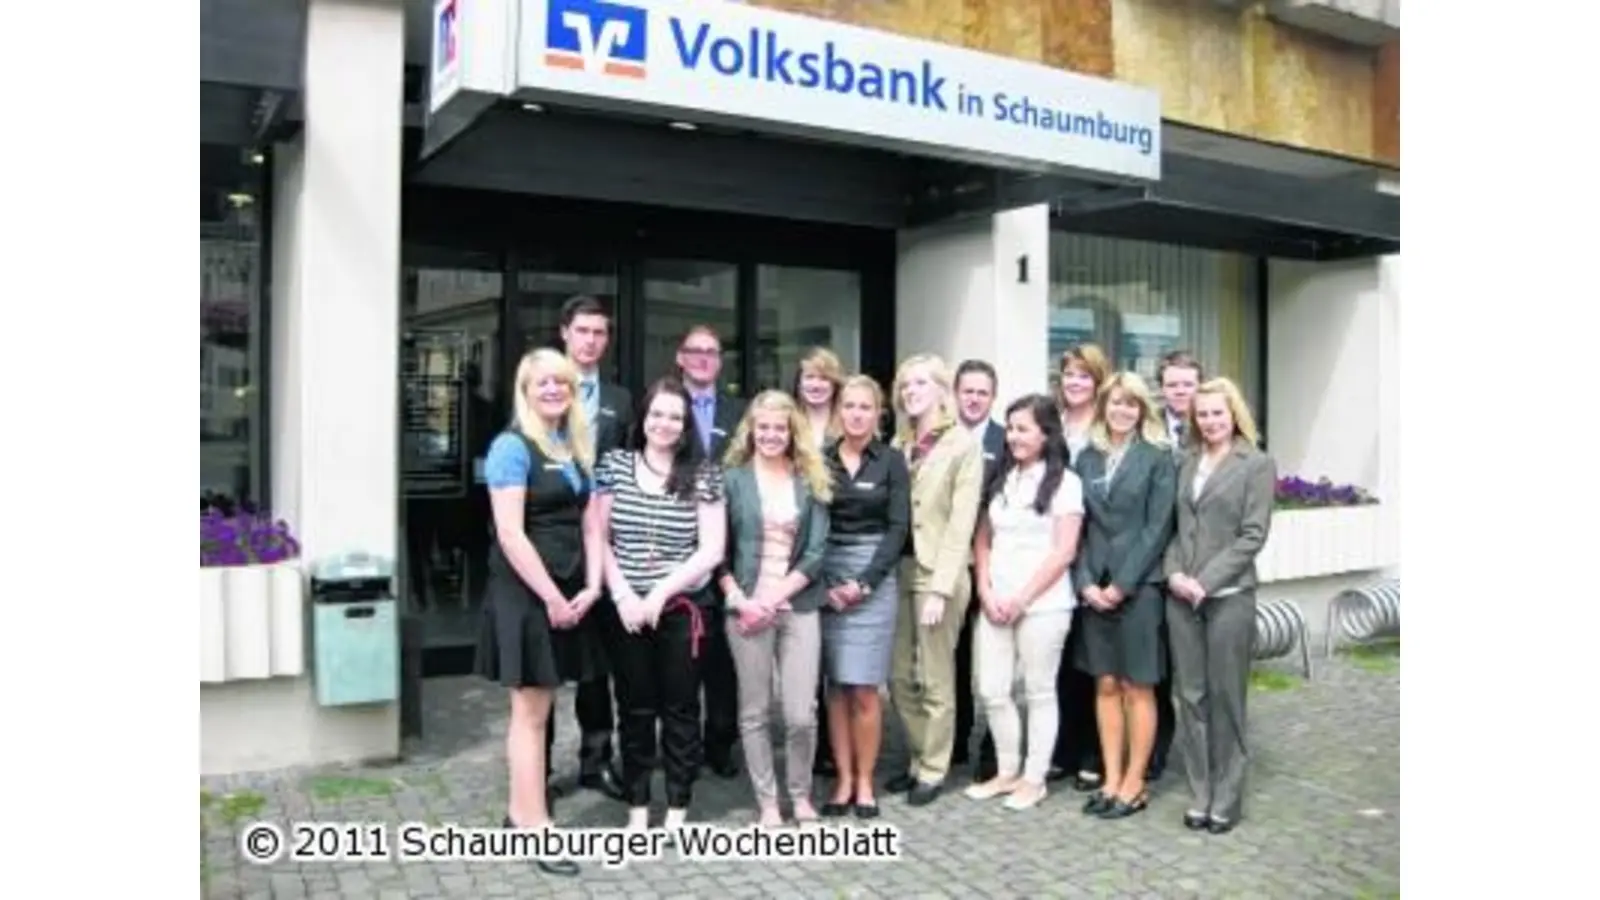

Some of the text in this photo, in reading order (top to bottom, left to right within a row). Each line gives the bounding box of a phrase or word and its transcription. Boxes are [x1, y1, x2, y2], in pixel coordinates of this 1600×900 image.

[669, 17, 1153, 155] Volksbank in Schaumburg
[1015, 254, 1030, 284] 1
